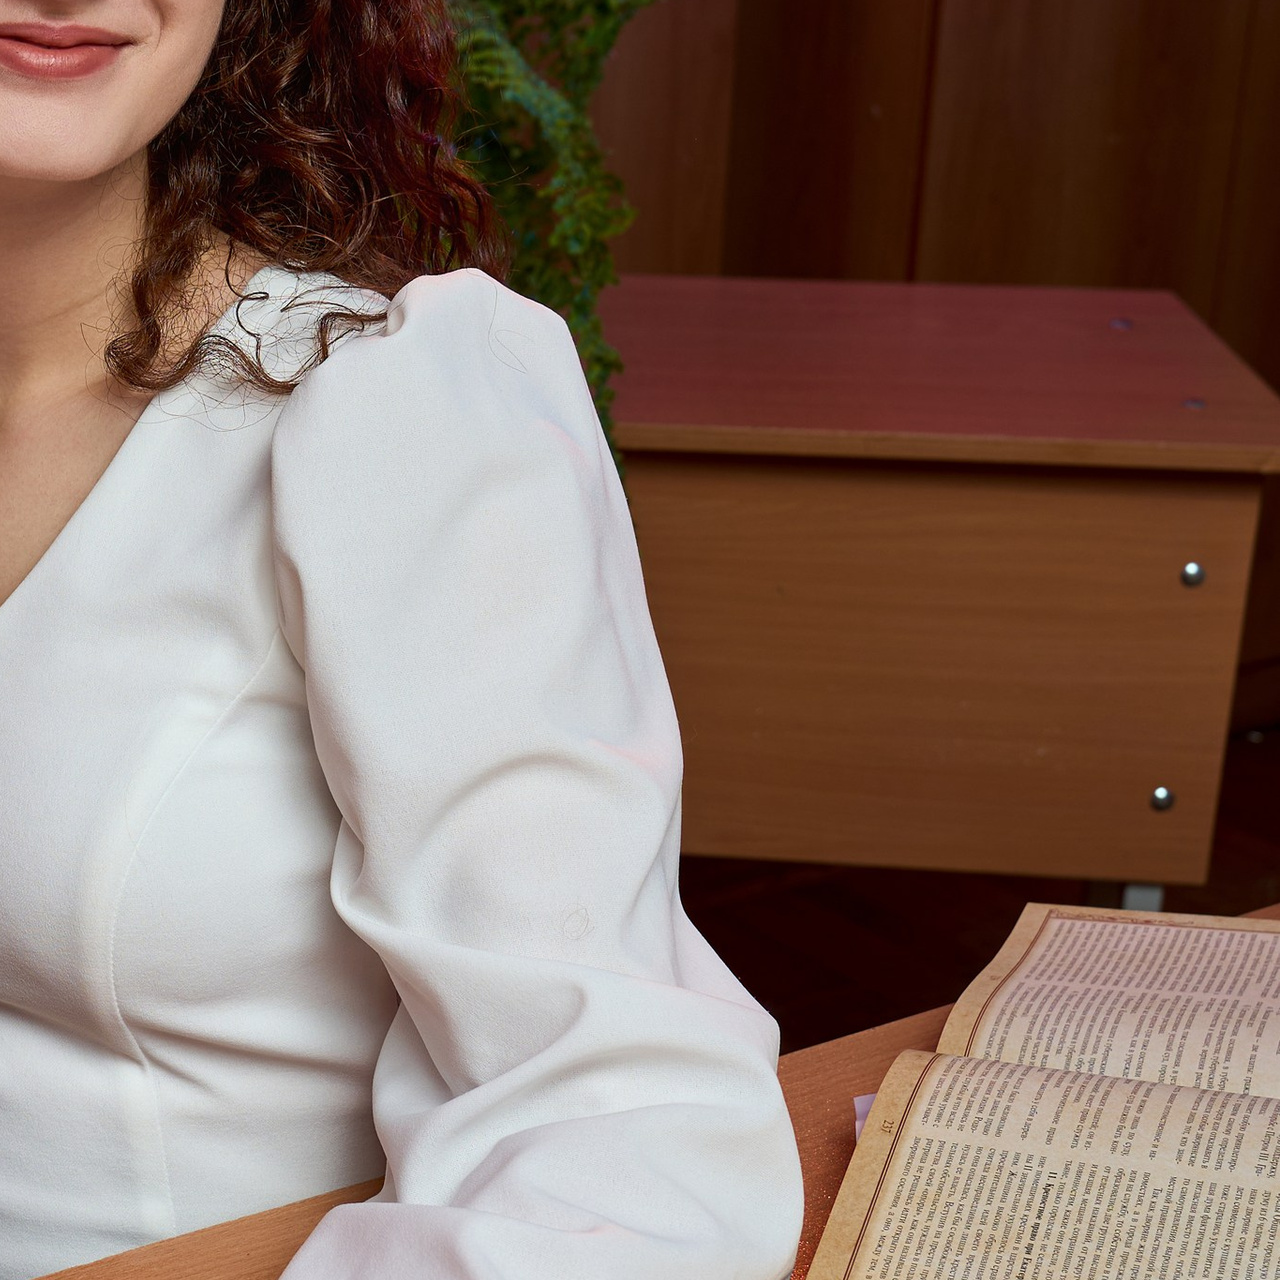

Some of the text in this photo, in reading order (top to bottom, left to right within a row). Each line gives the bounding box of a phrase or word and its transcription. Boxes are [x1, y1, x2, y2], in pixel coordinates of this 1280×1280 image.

[881, 1119, 895, 1134] 237
[970, 1116, 984, 1134] Родо-
[982, 1117, 995, 1137] право
[994, 1104, 1013, 1139] недовольно
[1113, 1124, 1127, 1140] быть
[1070, 1124, 1085, 1150] служить
[1187, 1132, 1204, 1168] дворянские
[1202, 1132, 1218, 1165] отказывать
[1261, 1130, 1276, 1153] Петром
[902, 1136, 922, 1177] дворянского
[919, 1138, 935, 1165] ратрица
[944, 1142, 960, 1169] тельных
[958, 1144, 972, 1167] нулась
[982, 1147, 997, 1174] считала
[1214, 1137, 1230, 1172] определять
[1227, 1132, 1245, 1173] привилегиро-
[924, 1168, 937, 1188] своей
[985, 1150, 1010, 1207] просветительных
[1128, 1170, 1139, 1184] или
[1254, 1163, 1267, 1178] Гра-
[904, 1174, 922, 1207] решалась
[964, 1174, 988, 1231] несправедливым
[1010, 1172, 1029, 1214] значительно
[1035, 1183, 1055, 1221] Крепостное
[1151, 1188, 1164, 1200] Так
[1164, 1176, 1178, 1205] местной
[1189, 1180, 1205, 1214] тигласная
[1259, 1190, 1272, 1208] думу
[898, 1207, 911, 1225] идти
[937, 1201, 955, 1230] Вступив
[979, 1209, 991, 1227] идей
[1147, 1200, 1158, 1214] как
[904, 1231, 915, 1245] она
[909, 1219, 920, 1232] как
[997, 1213, 1017, 1255] ухудшилось
[1029, 1222, 1041, 1242] право
[1140, 1213, 1154, 1244] дворяне
[1146, 1205, 1170, 1273] правительственной
[1183, 1214, 1196, 1240] вместо
[872, 1235, 888, 1258] между
[888, 1225, 904, 1254] открыто
[914, 1225, 932, 1257] нуждаясь
[955, 1231, 970, 1258] лишать
[971, 1228, 984, 1252] своего
[1024, 1242, 1035, 1256] при
[1105, 1228, 1123, 1270] собственно
[879, 1254, 894, 1280] против
[893, 1245, 911, 1278] называла
[924, 1240, 940, 1268] престол
[1134, 1243, 1146, 1264] жили
